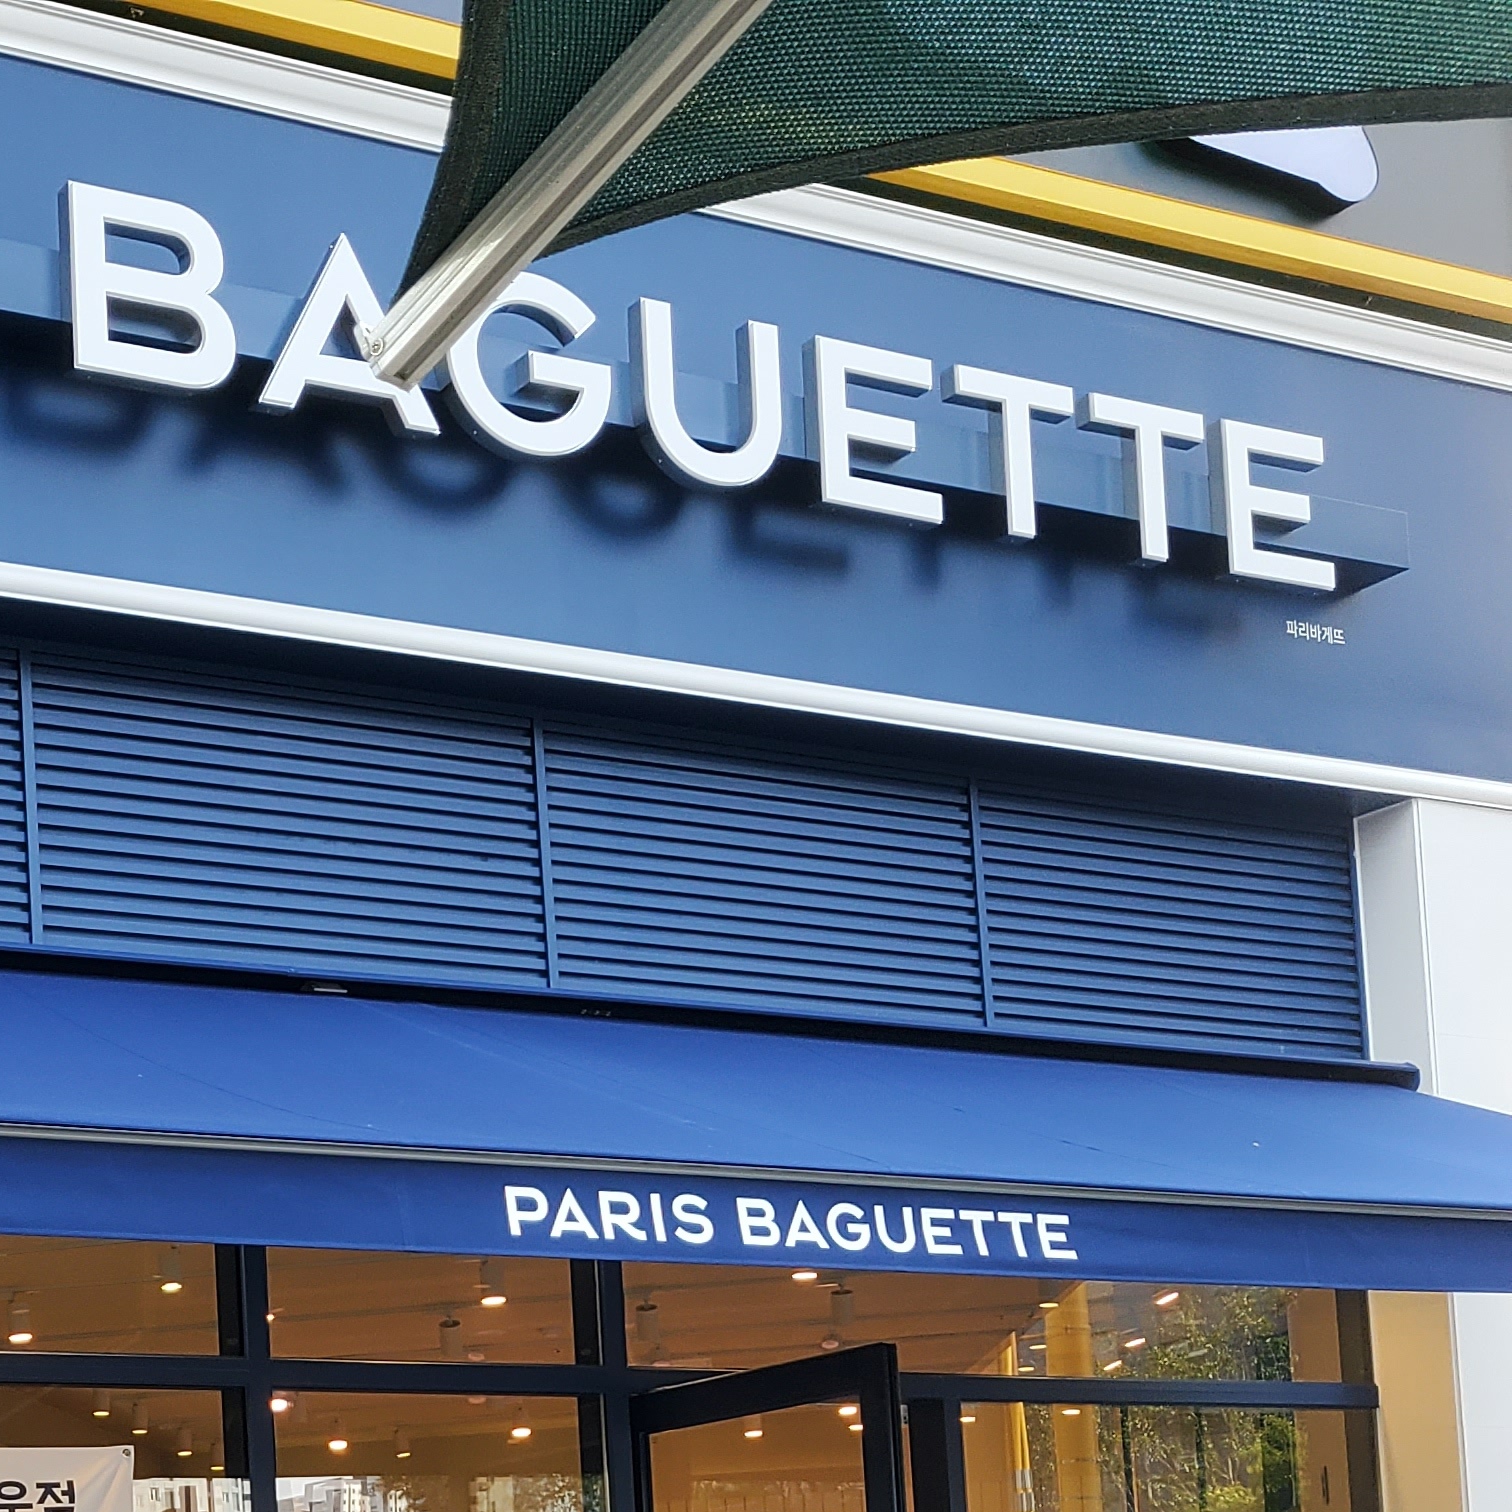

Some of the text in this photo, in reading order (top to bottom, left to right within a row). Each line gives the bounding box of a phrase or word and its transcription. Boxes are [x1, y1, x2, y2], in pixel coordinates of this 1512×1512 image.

[58, 180, 1337, 592] BAGUETTE
[1285, 619, 1346, 645] 파리바게뜨
[503, 1184, 1079, 1261] PARIS BAGUETTE
